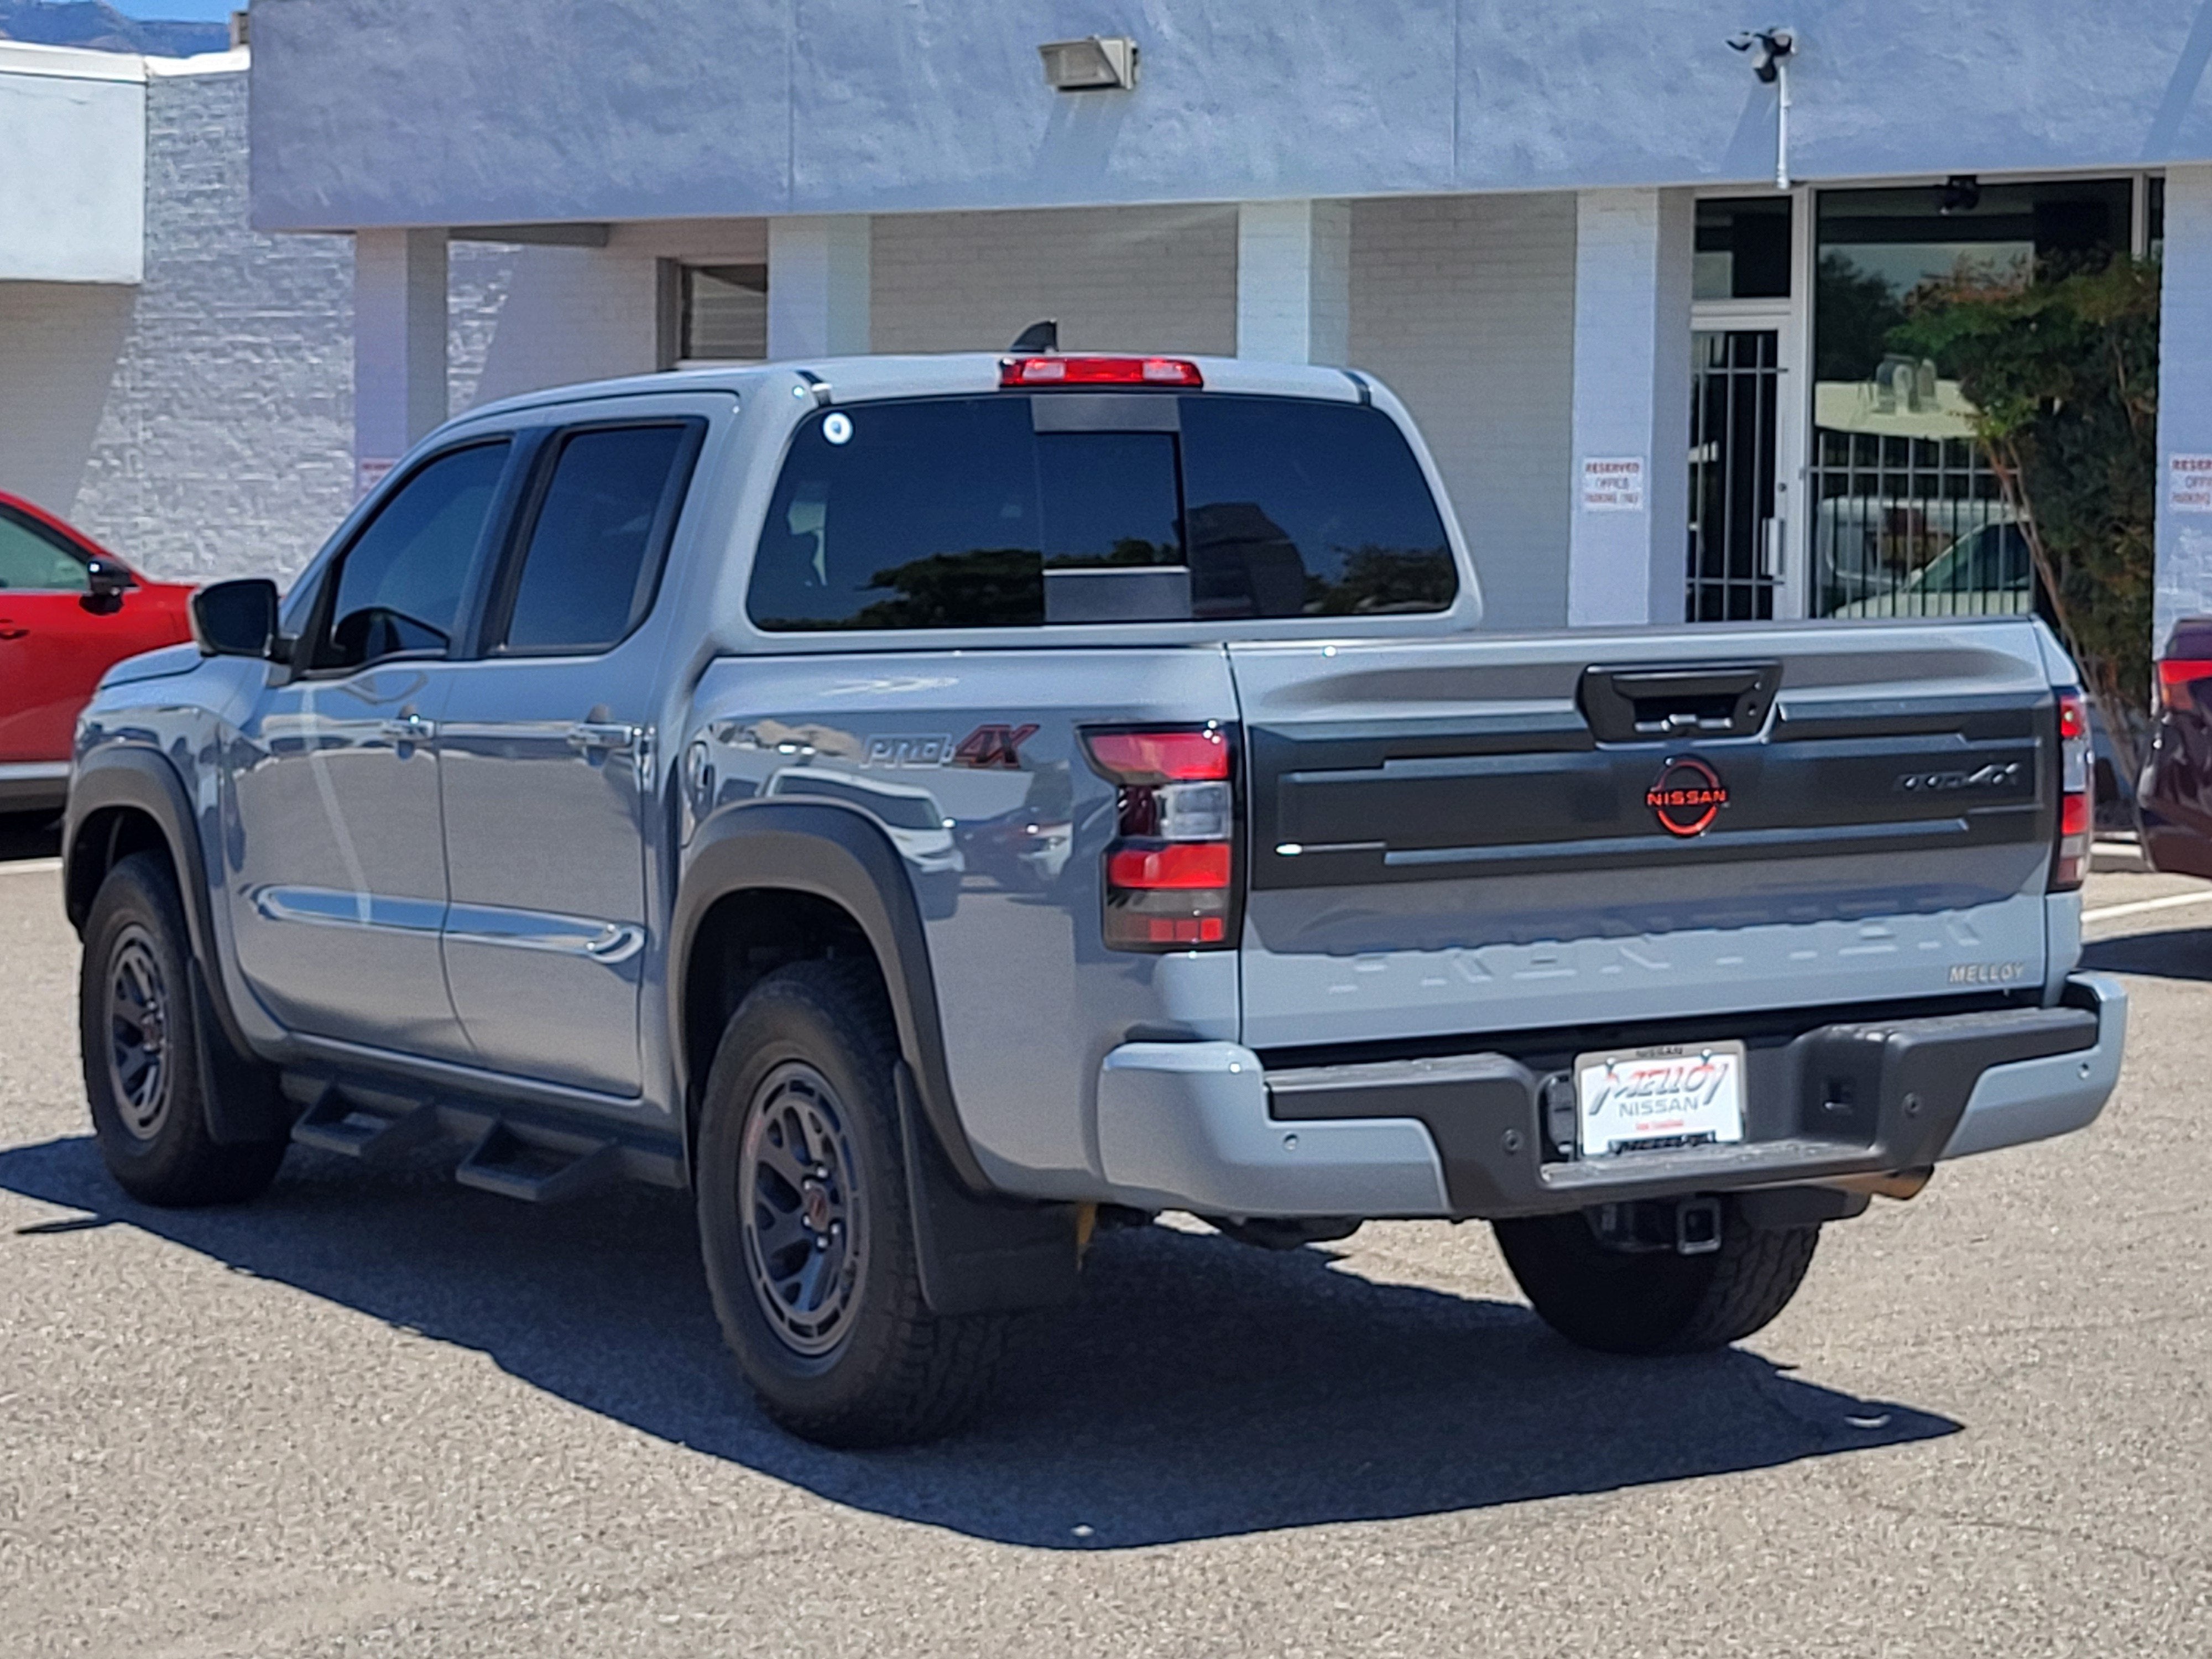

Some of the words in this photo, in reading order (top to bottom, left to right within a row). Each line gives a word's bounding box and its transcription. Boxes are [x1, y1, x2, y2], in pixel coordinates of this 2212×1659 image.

[1585, 462, 1640, 473] RESERVED
[1646, 789, 1726, 806] NISSAN
[1949, 963, 2025, 983] MELLOY
[1619, 1096, 1699, 1118] NISSAN
